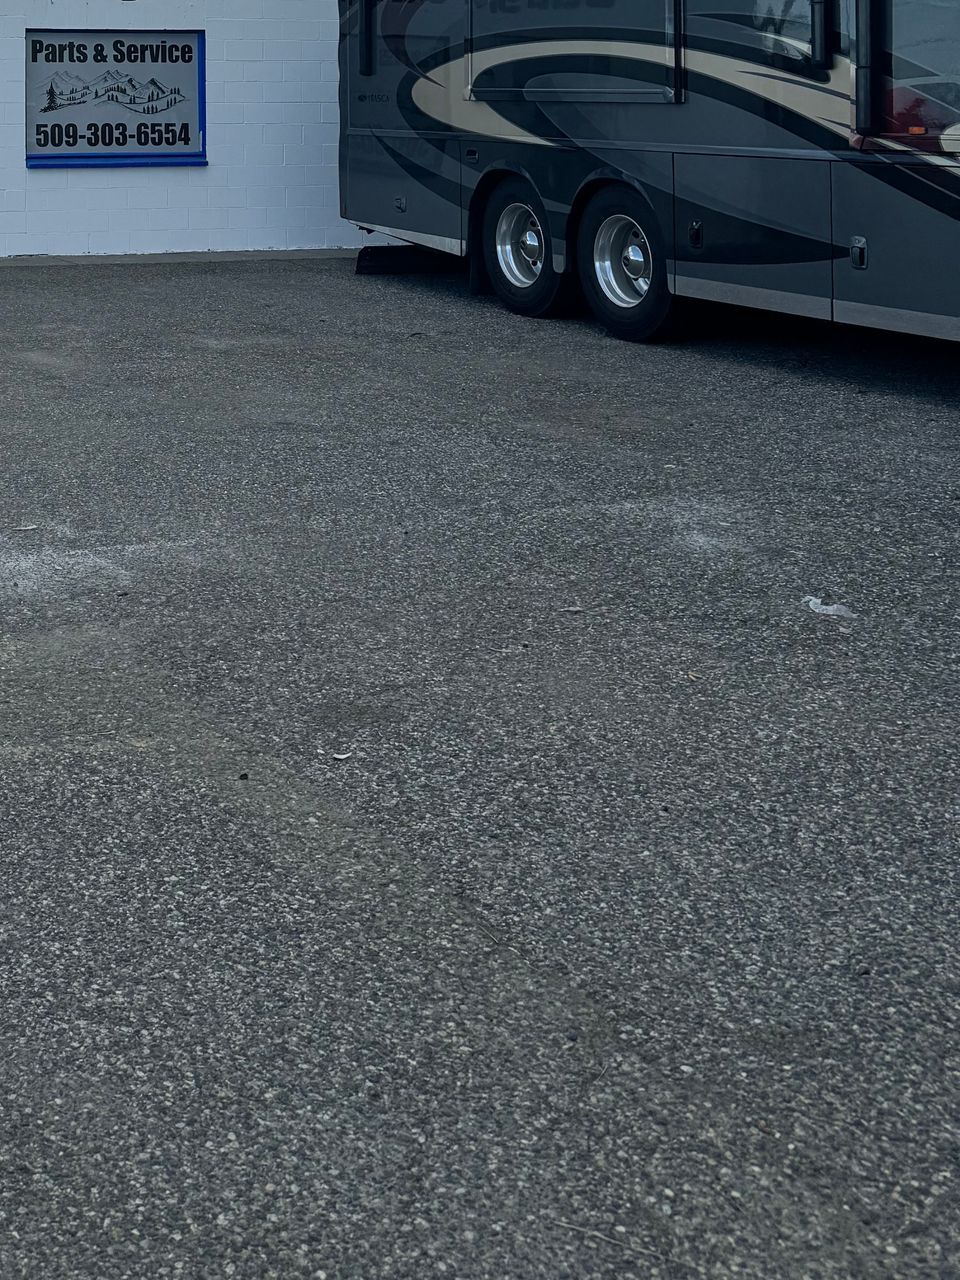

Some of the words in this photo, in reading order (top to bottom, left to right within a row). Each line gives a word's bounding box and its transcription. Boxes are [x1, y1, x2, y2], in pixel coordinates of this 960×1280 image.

[32, 40, 88, 63] Parts
[93, 42, 108, 63] &
[113, 40, 193, 63] Service
[36, 123, 191, 147] 509-303-6554
